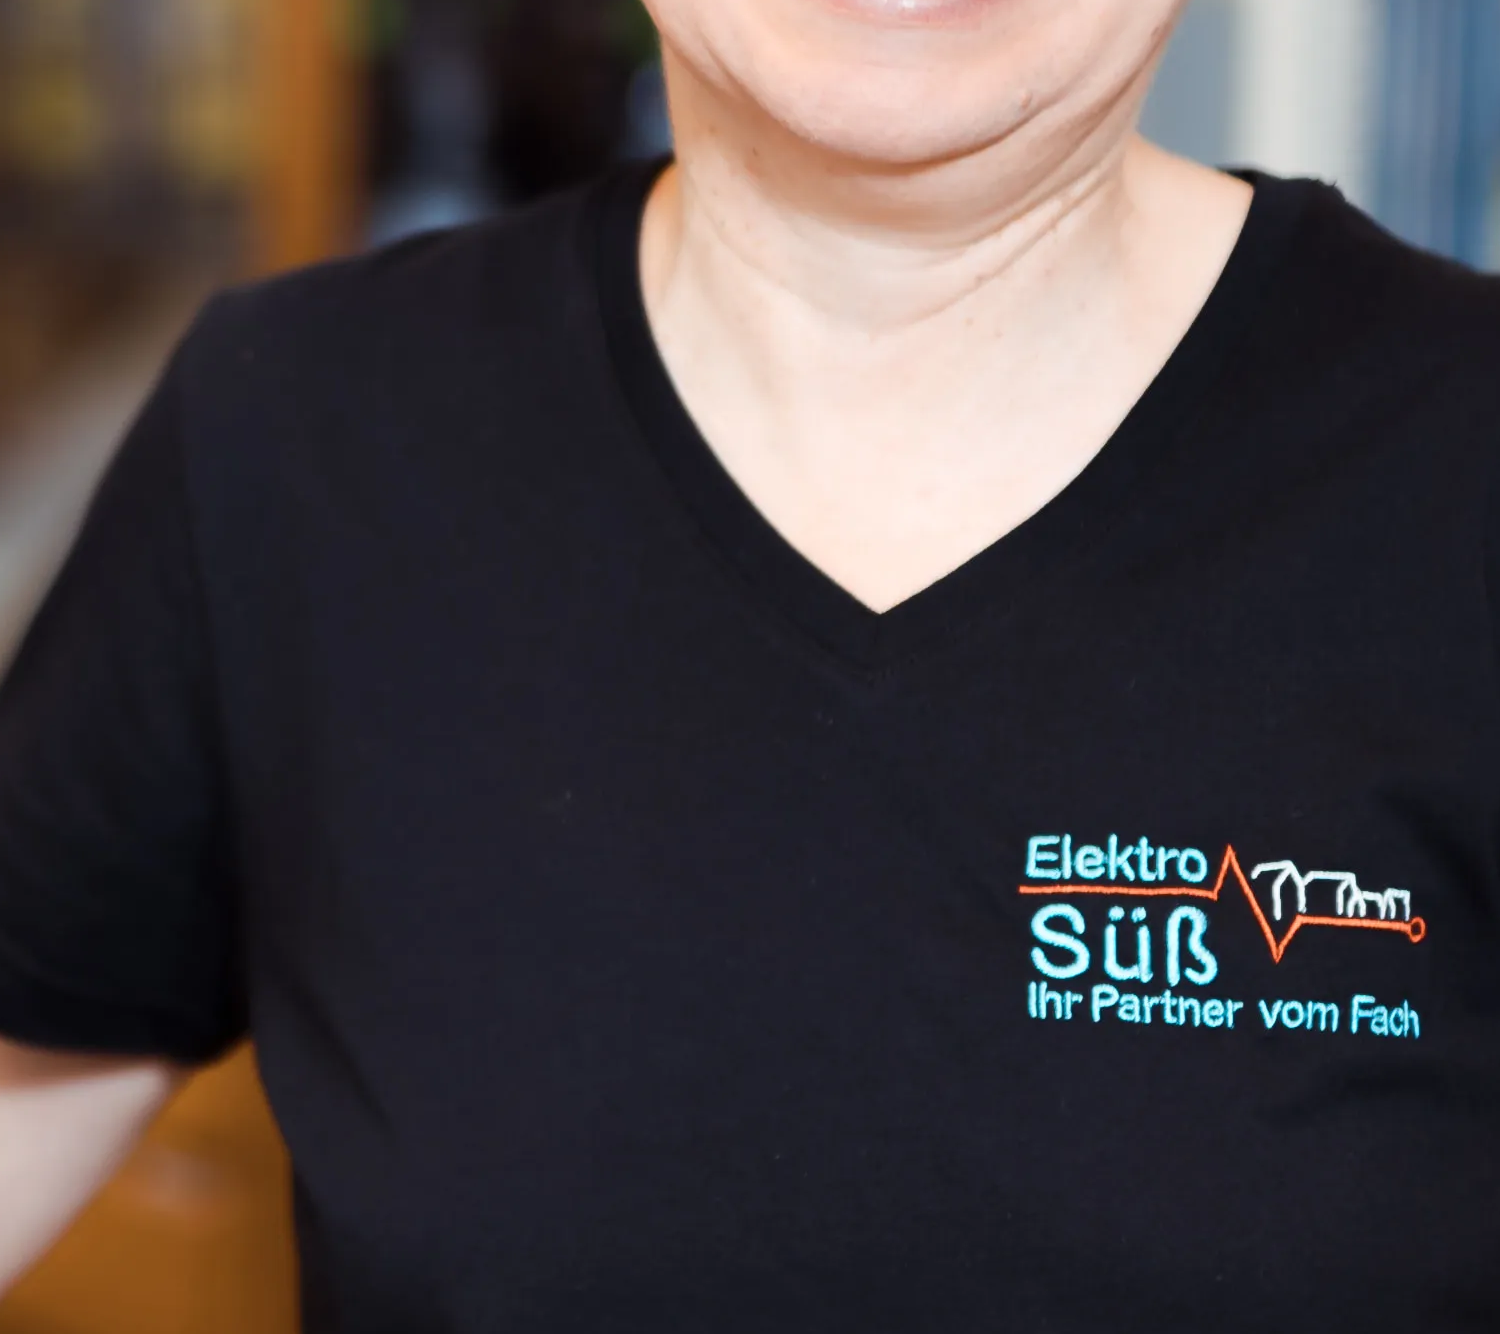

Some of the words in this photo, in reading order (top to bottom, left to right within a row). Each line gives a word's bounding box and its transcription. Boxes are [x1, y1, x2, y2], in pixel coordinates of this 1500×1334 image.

[1025, 832, 1208, 884] Elektro
[1030, 902, 1219, 987] Süß
[1026, 980, 1084, 1020] Ihr
[1090, 983, 1244, 1029] Partner
[1258, 997, 1339, 1033] vom
[1350, 993, 1421, 1040] Fach
